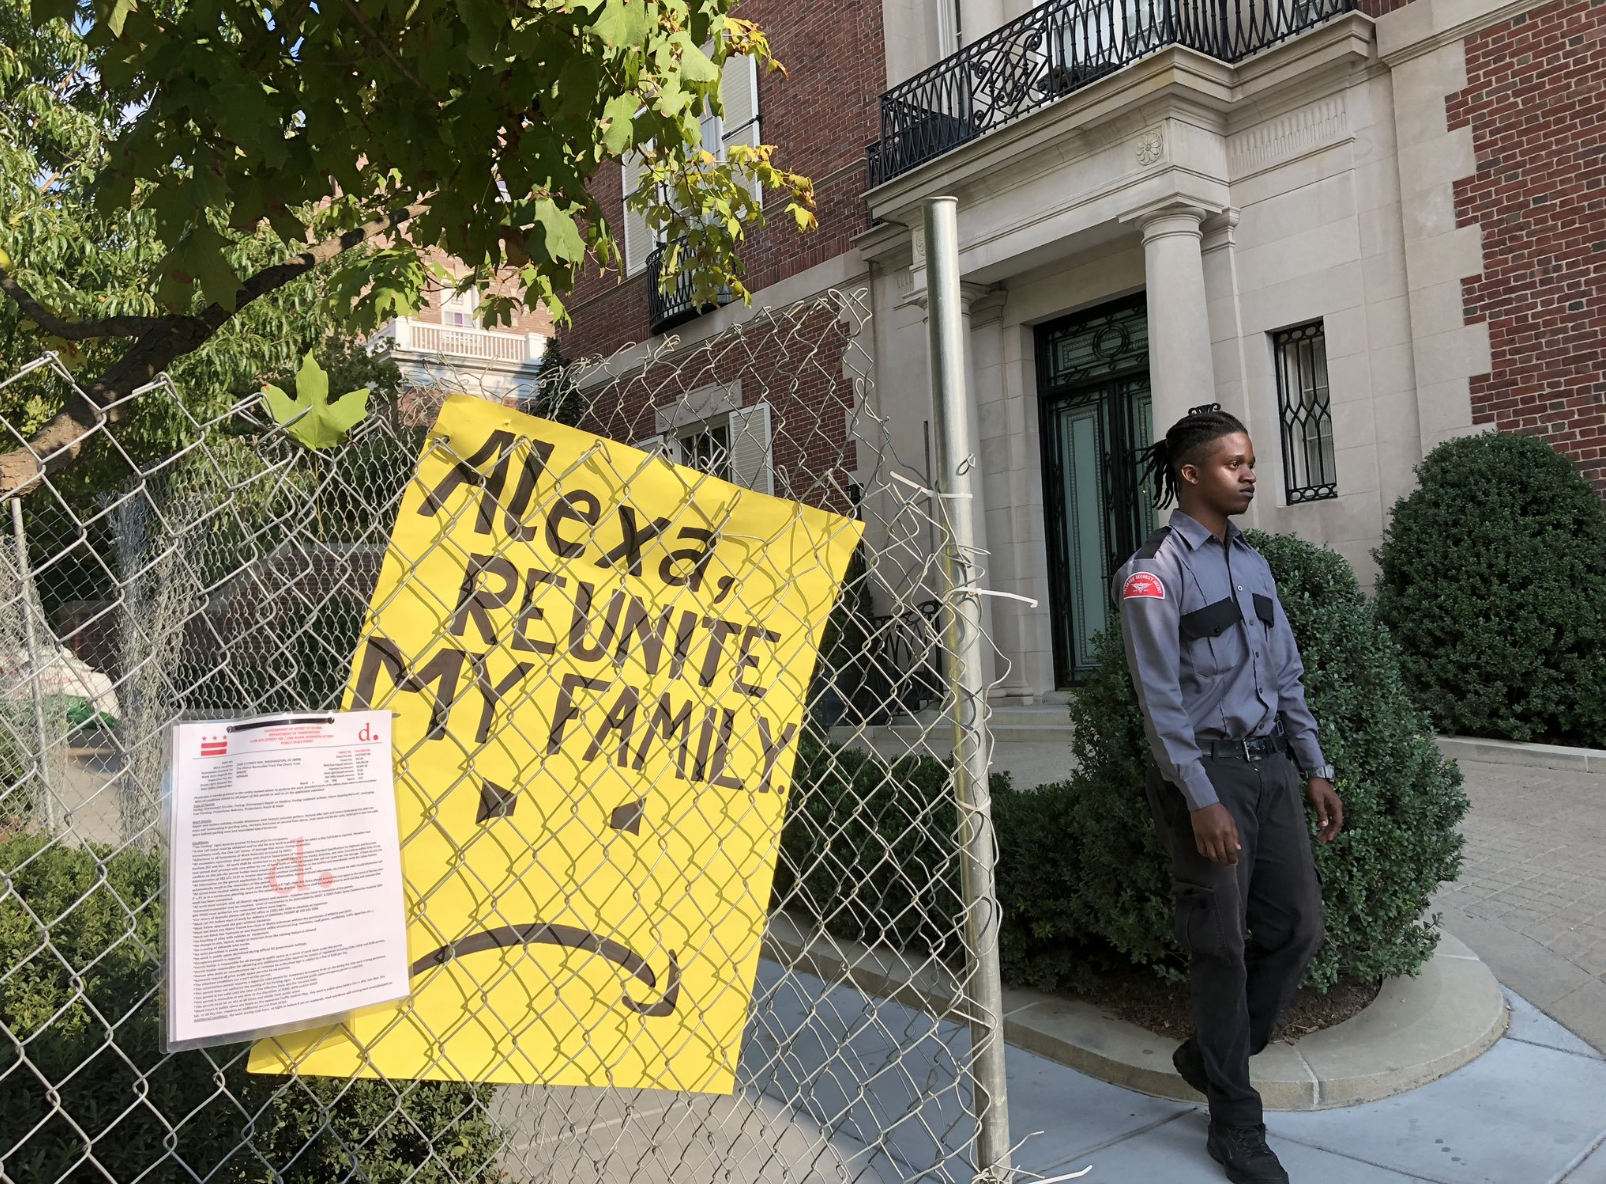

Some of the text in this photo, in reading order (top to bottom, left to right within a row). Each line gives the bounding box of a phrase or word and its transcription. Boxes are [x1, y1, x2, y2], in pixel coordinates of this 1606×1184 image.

[416, 429, 735, 603] Alexa,
[449, 552, 782, 699] REUNITE
[350, 635, 797, 795] MY FAMILY.
